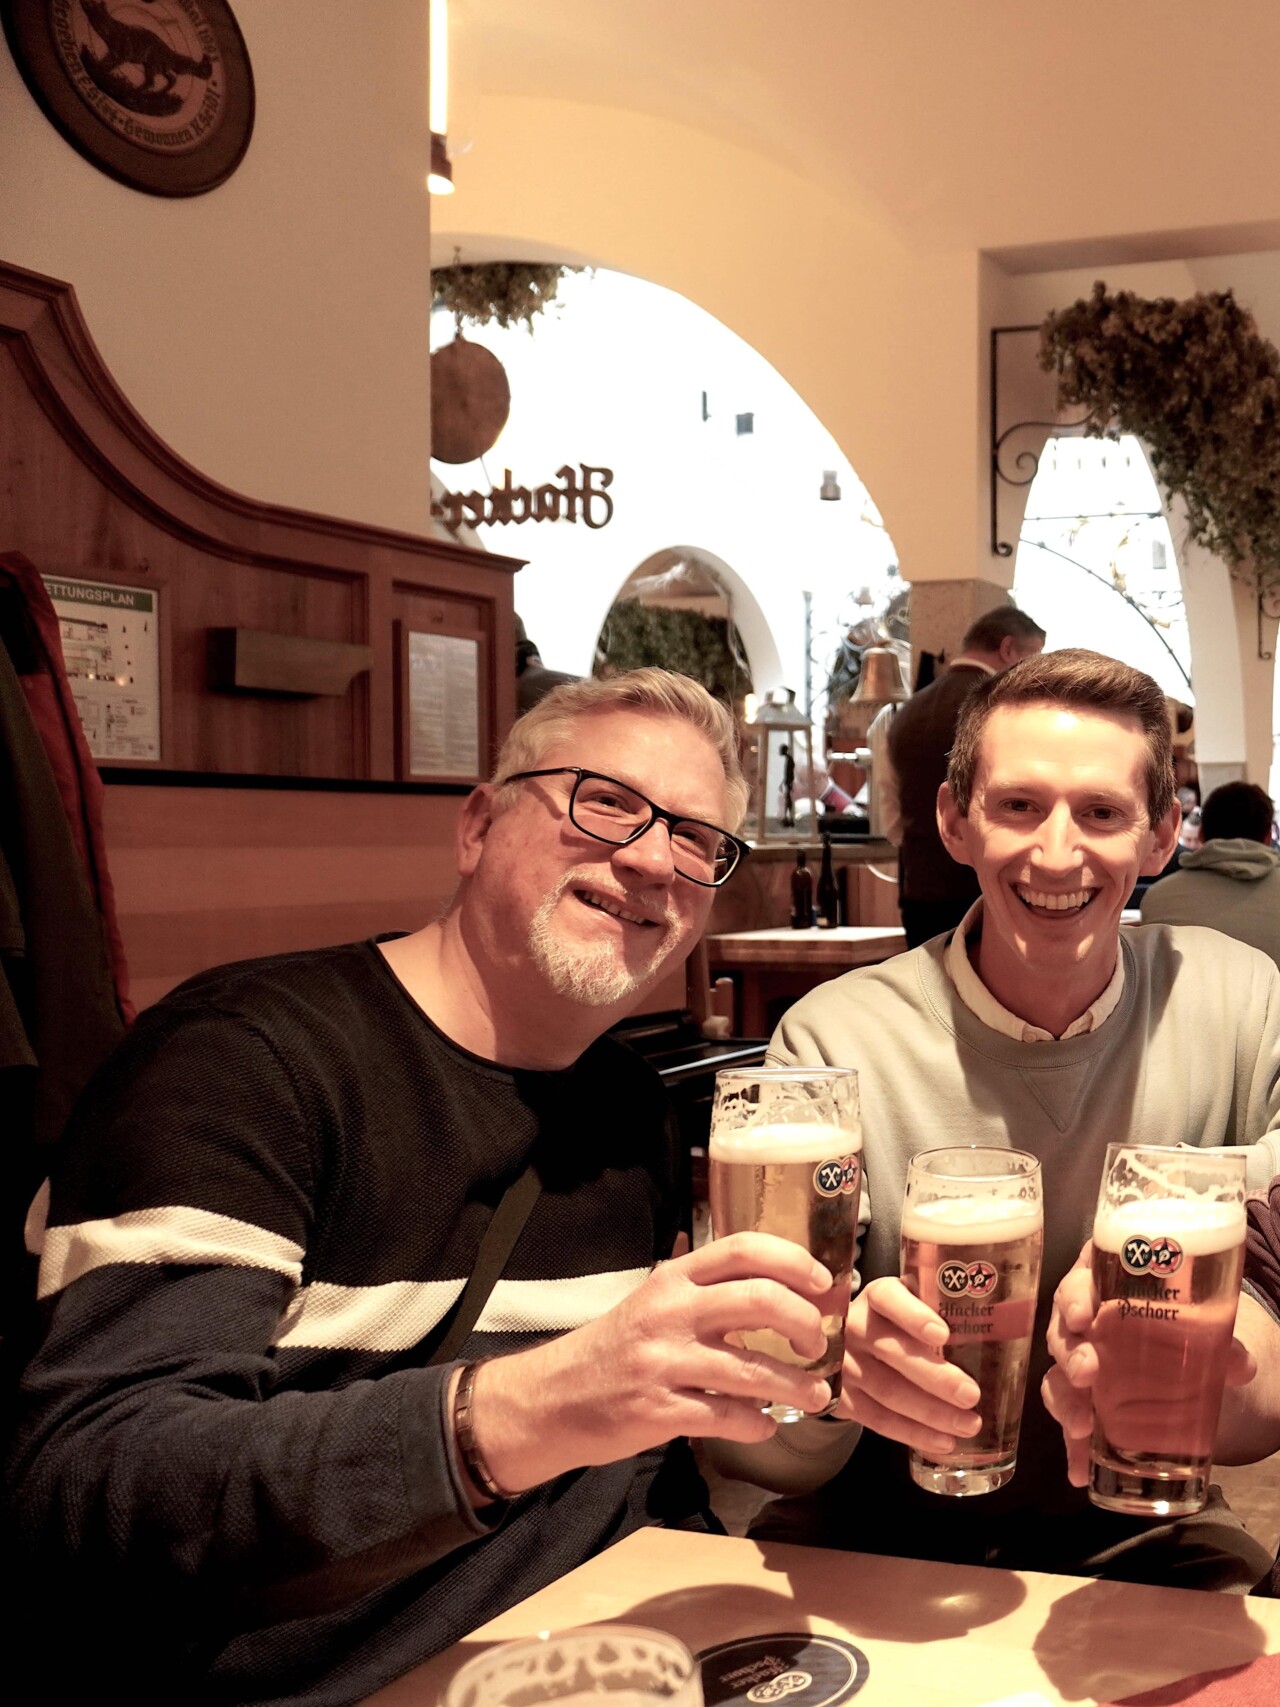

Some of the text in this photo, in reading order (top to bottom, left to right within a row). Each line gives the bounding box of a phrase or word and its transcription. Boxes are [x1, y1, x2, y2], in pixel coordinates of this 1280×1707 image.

[46, 583, 135, 607] ETTUNGSPLAN
[938, 1302, 994, 1318] Hacker
[1117, 1298, 1180, 1320] Pschorr
[950, 1320, 994, 1335] schorr
